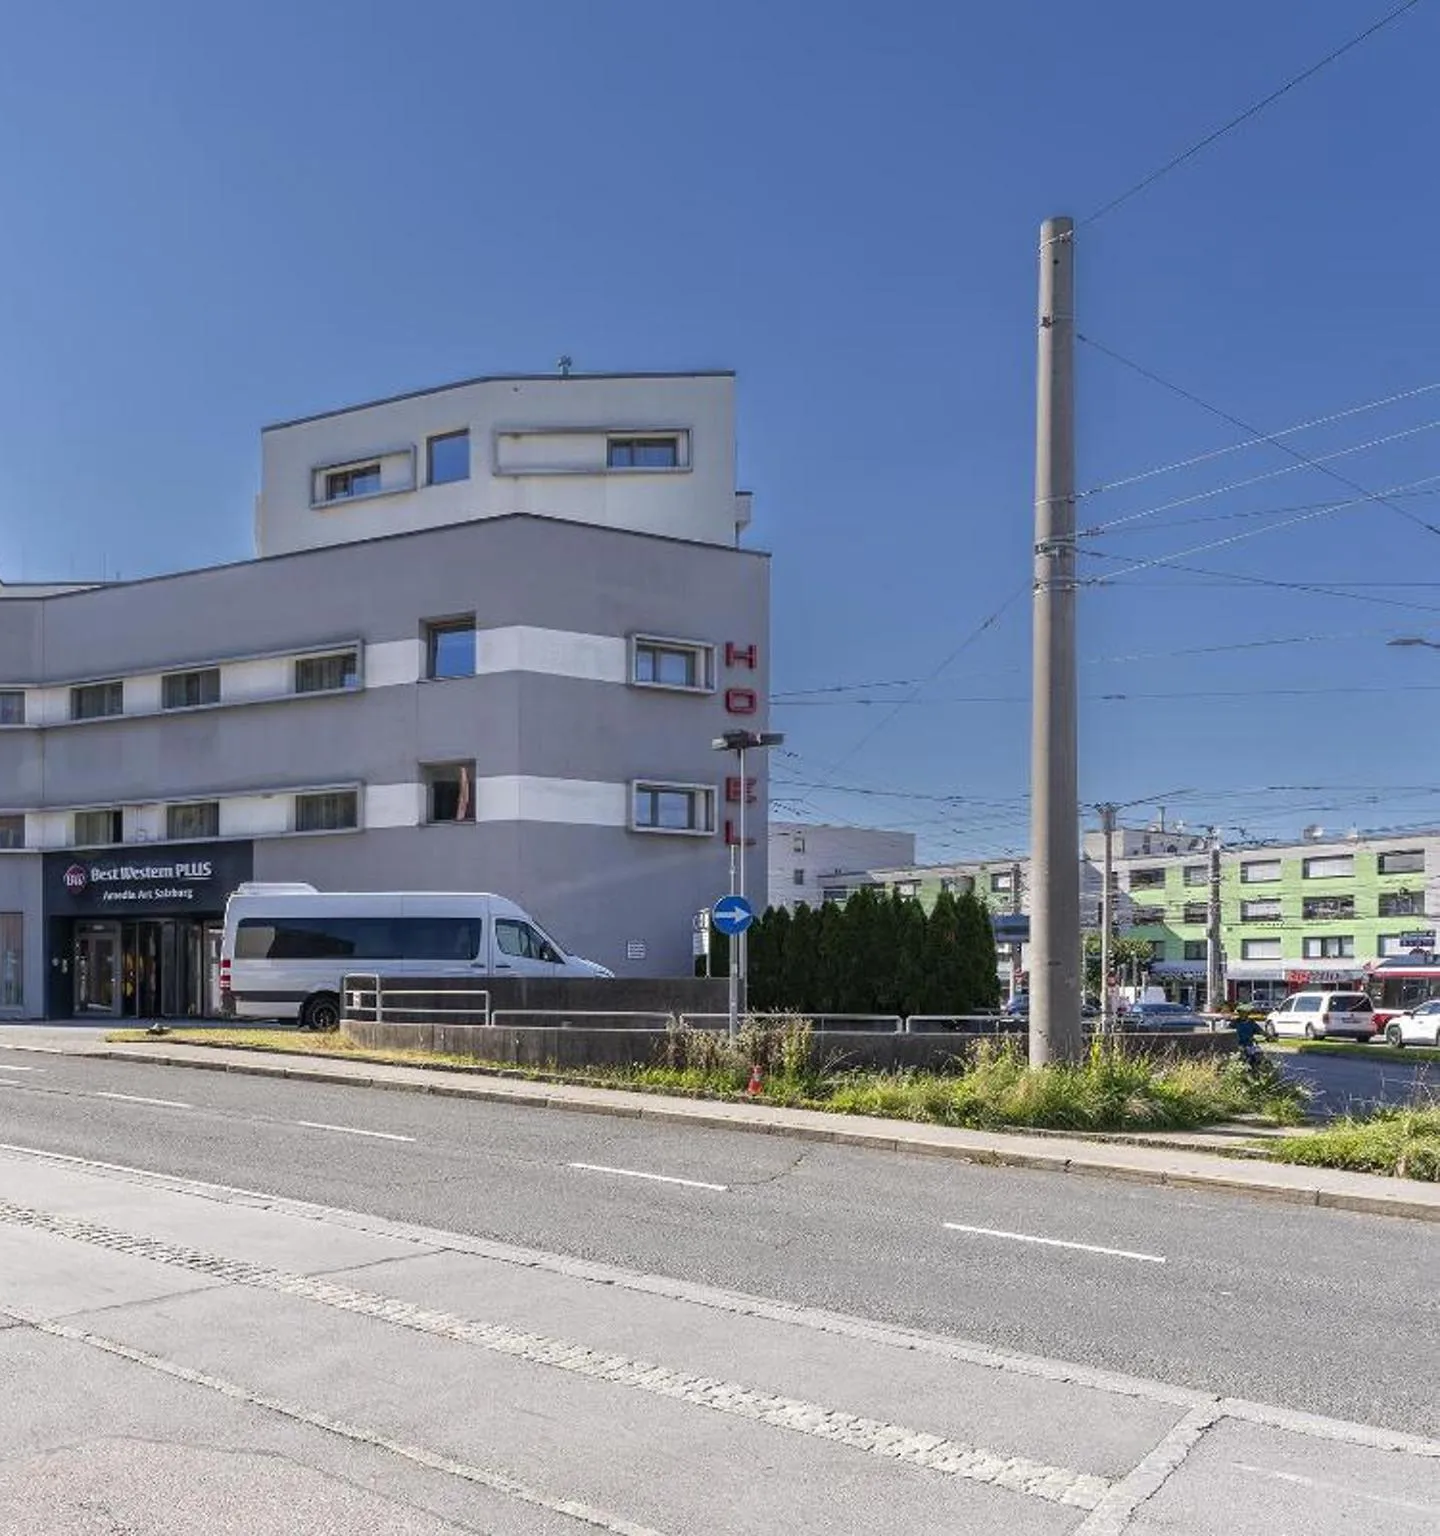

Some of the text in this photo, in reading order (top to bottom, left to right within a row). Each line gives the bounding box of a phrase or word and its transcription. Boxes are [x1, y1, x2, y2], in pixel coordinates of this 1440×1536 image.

[725, 641, 757, 846] HOEL
[91, 861, 213, 882] Best Western PLUS
[137, 889, 153, 900] Art
[154, 887, 194, 900] Salzburg
